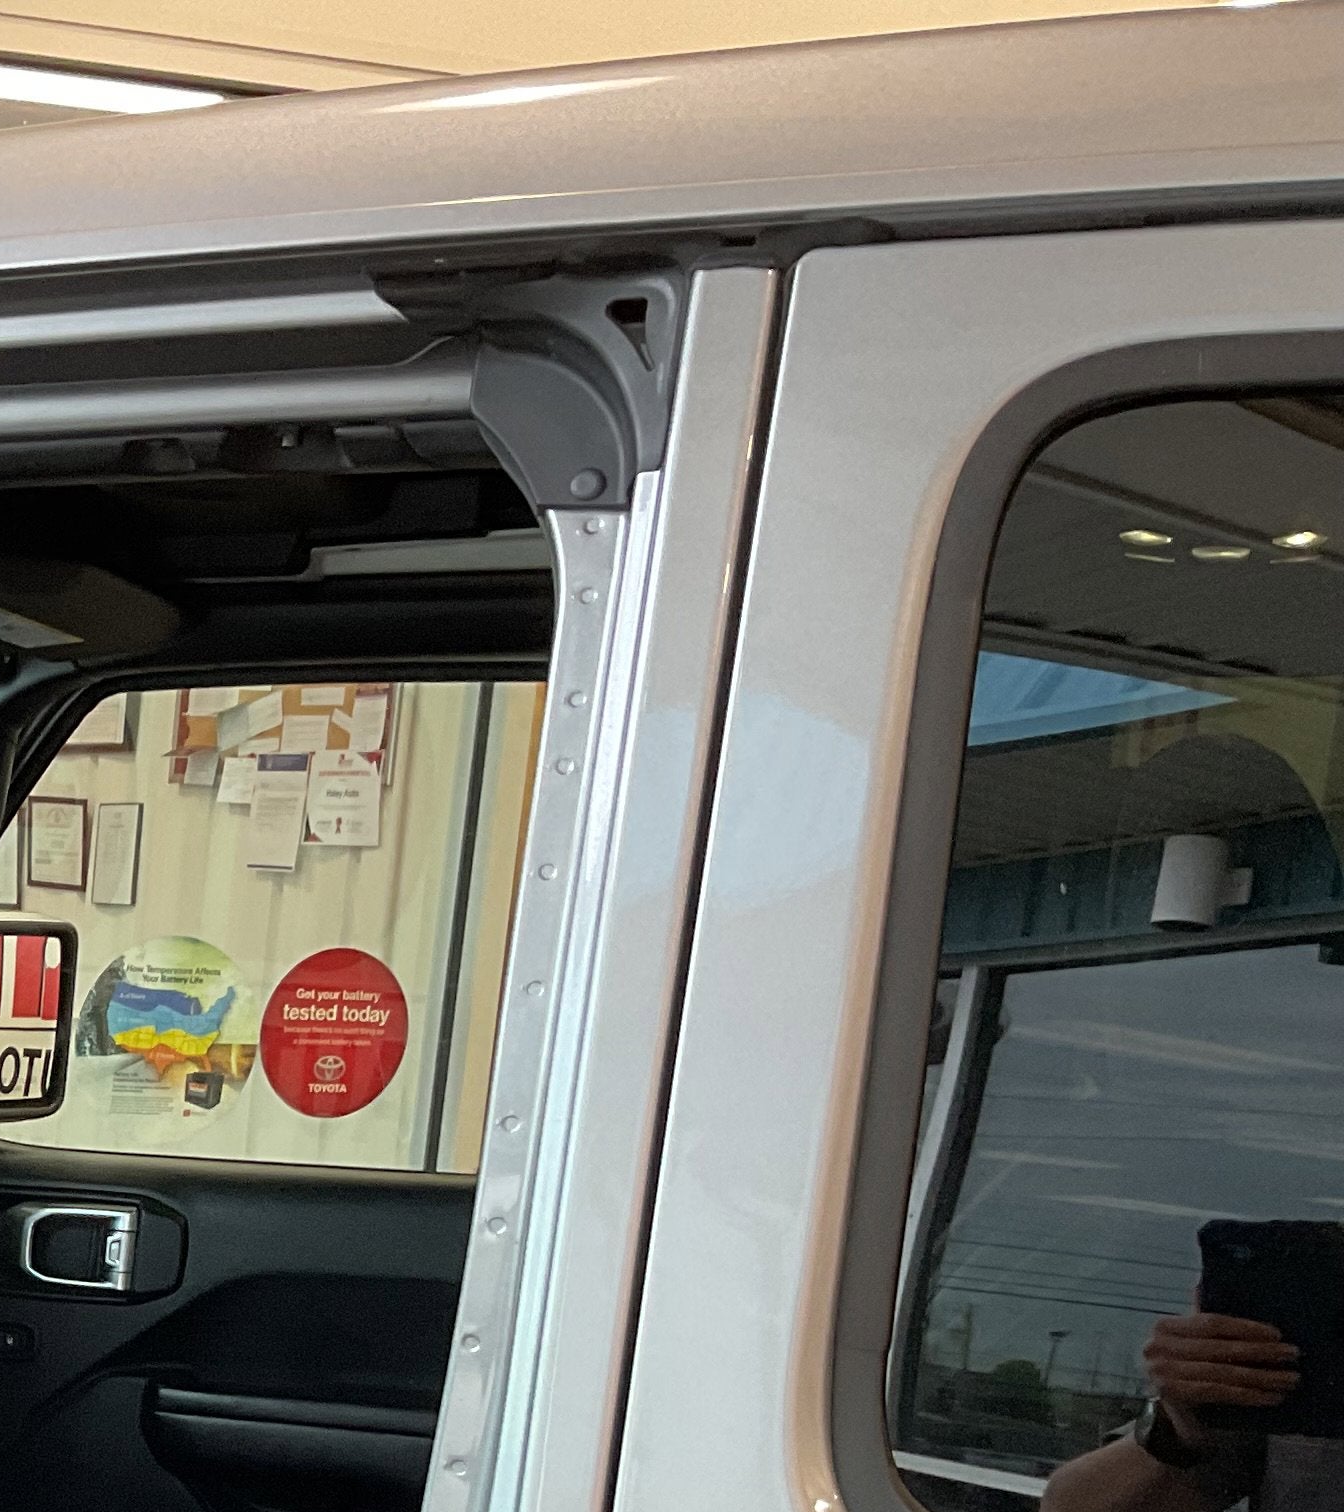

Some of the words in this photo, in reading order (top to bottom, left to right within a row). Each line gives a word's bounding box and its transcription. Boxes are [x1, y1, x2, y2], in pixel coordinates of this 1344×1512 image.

[142, 974, 159, 983] Your
[160, 975, 188, 984] Battery
[189, 976, 204, 984] Life
[296, 988, 315, 1000] Get
[318, 990, 341, 1002] your
[343, 990, 382, 1003] battery
[283, 1004, 338, 1021] tested
[343, 1005, 390, 1027] today
[308, 1083, 347, 1093] TOYOTA
